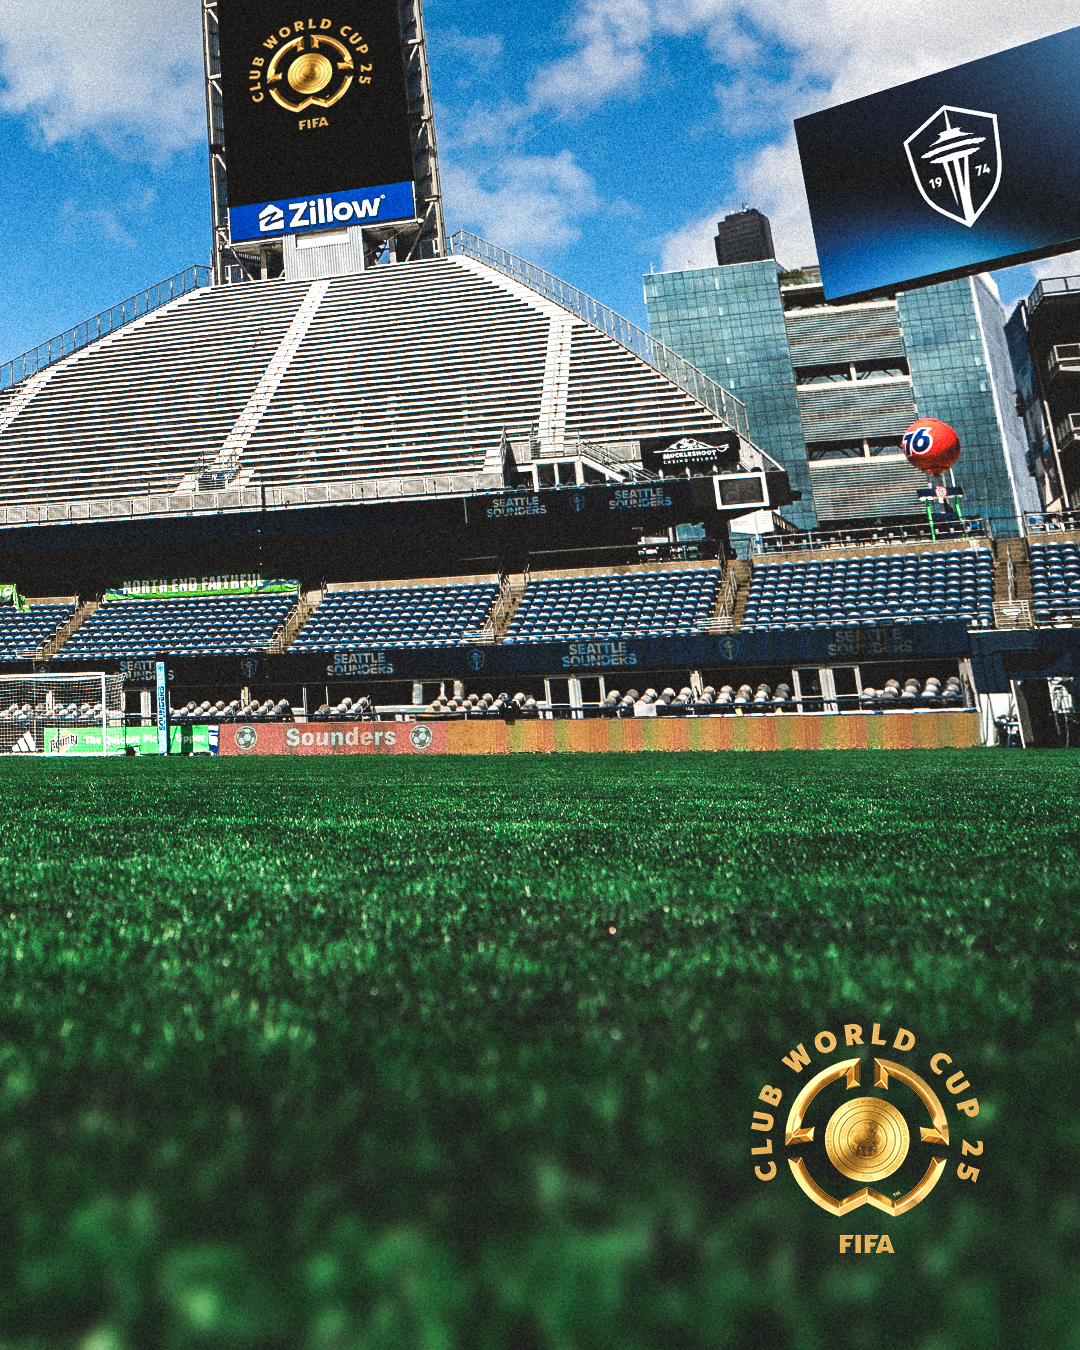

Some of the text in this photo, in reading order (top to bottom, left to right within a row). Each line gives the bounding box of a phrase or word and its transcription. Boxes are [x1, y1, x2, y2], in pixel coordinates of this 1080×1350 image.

[249, 18, 372, 103] CLUB WORLD CUP 25
[298, 116, 329, 130] FIFA
[928, 163, 991, 189] 19 74
[288, 197, 382, 228] Zillow
[615, 487, 663, 499] SEATTLE
[492, 496, 539, 507] SEATTLE
[609, 496, 672, 509] SOUNDERS
[487, 505, 547, 517] SOUNDERS
[122, 573, 264, 595] NORTH END FAITHFUL
[568, 641, 627, 656] SEATTLE
[333, 653, 385, 664] SEATTLE
[562, 653, 637, 668] SOUNDERS
[327, 663, 393, 675] SOUNDERS
[50, 732, 78, 753] Bounty
[84, 735, 101, 745] The
[286, 727, 397, 746] Sounders
